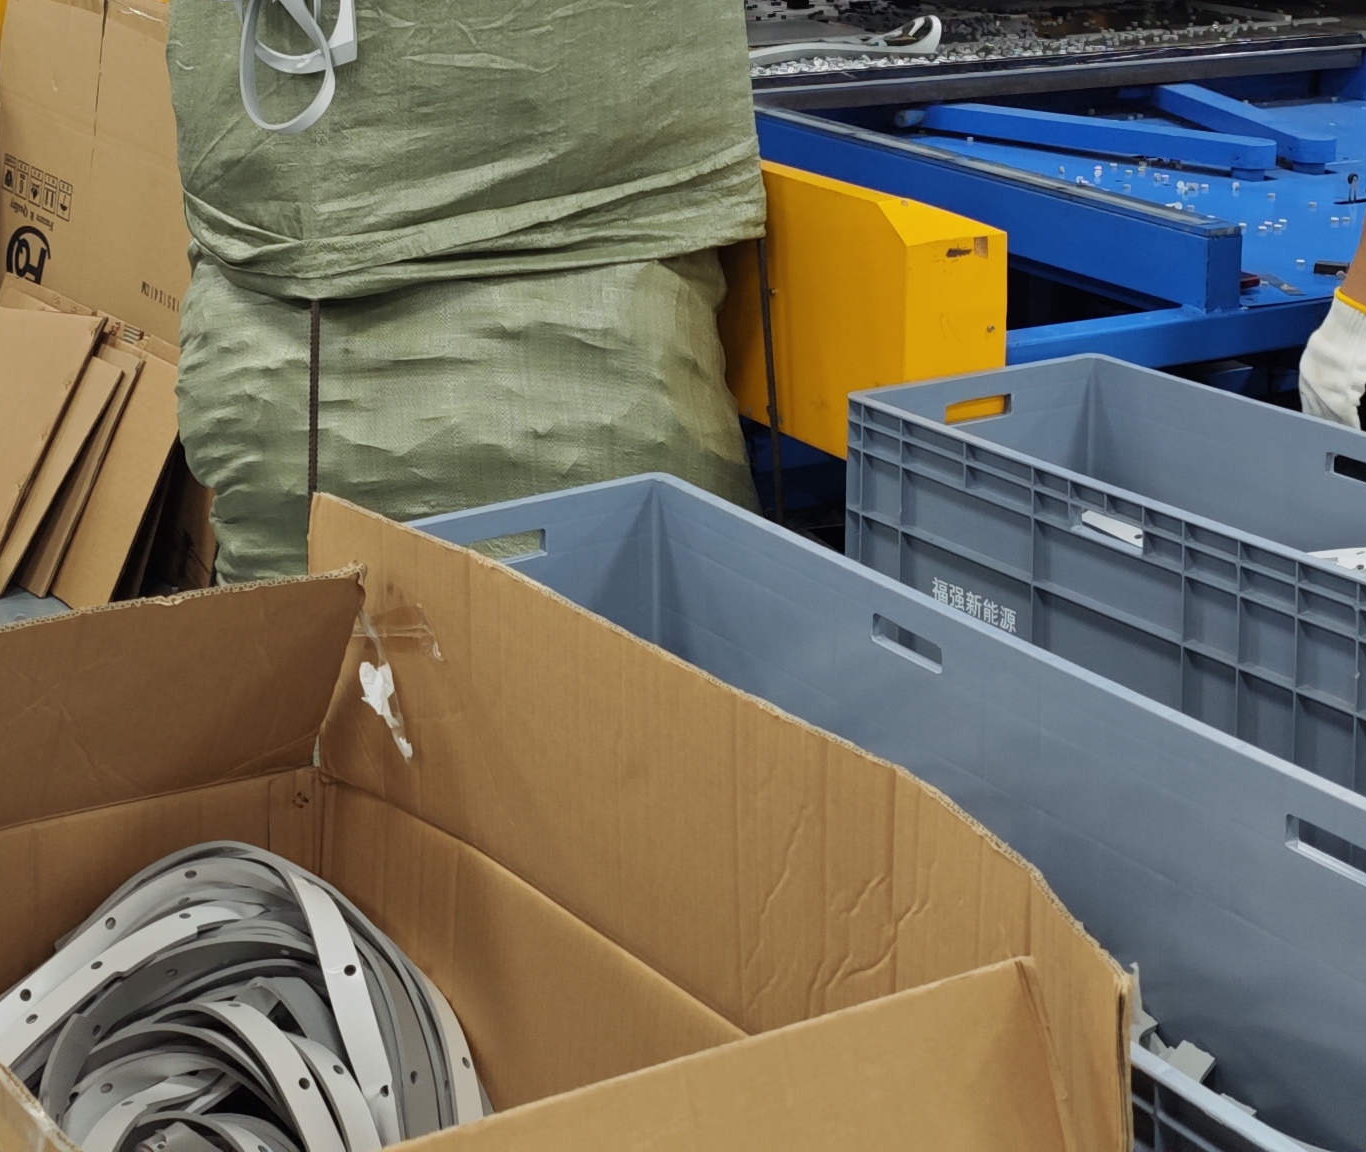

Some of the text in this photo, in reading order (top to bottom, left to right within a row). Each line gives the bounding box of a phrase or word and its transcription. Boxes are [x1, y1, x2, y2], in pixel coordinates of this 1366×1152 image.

[141, 280, 180, 314] 1X51X41CM
[931, 577, 1017, 634] 福强新能源
